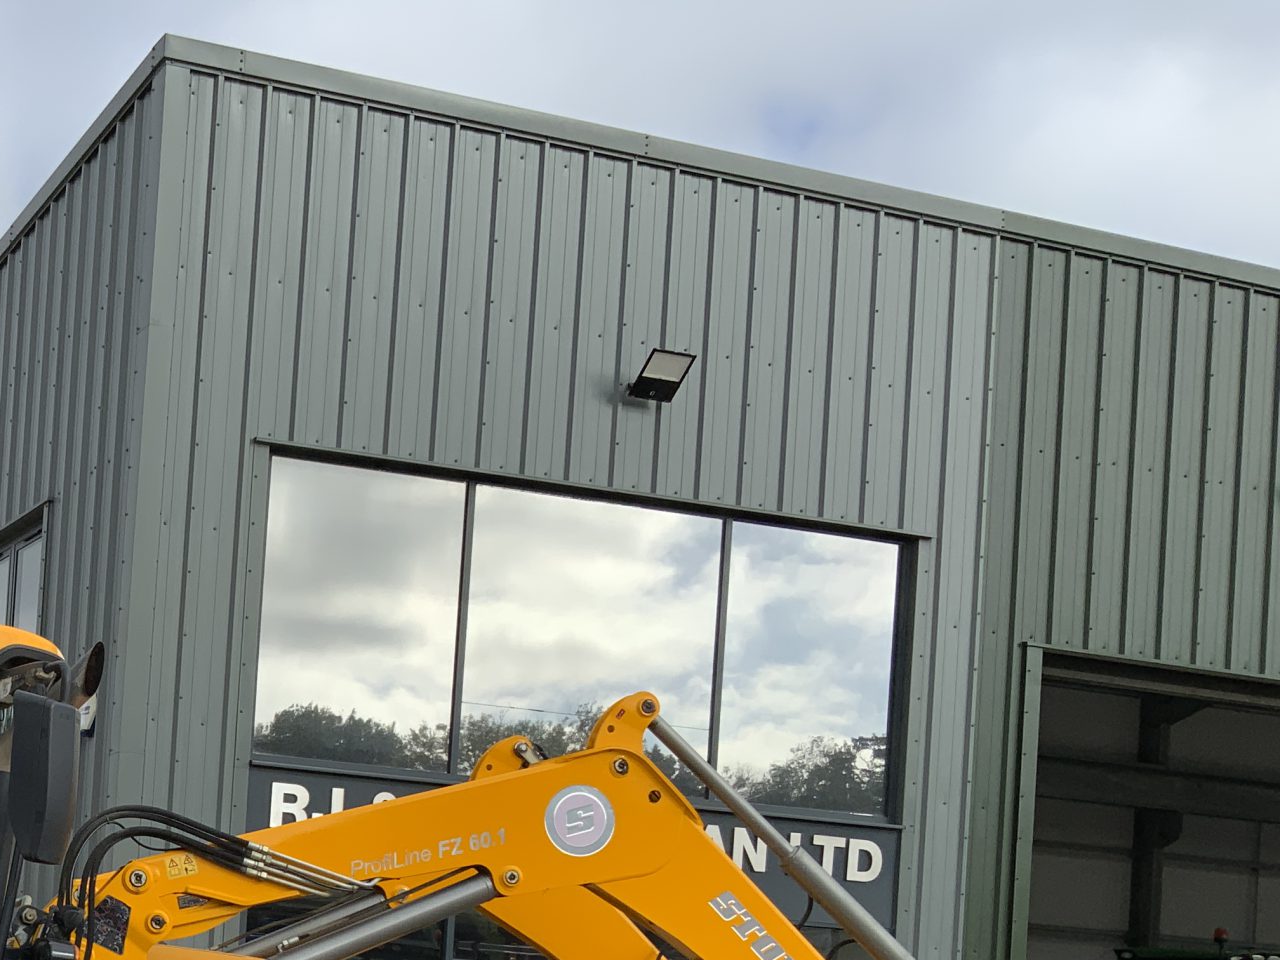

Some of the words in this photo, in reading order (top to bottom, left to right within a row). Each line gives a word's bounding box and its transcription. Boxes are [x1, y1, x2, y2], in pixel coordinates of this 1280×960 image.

[350, 847, 432, 876] ProfiLine
[438, 836, 463, 859] FZ
[469, 827, 507, 851] 60.1
[790, 832, 883, 882] TD
